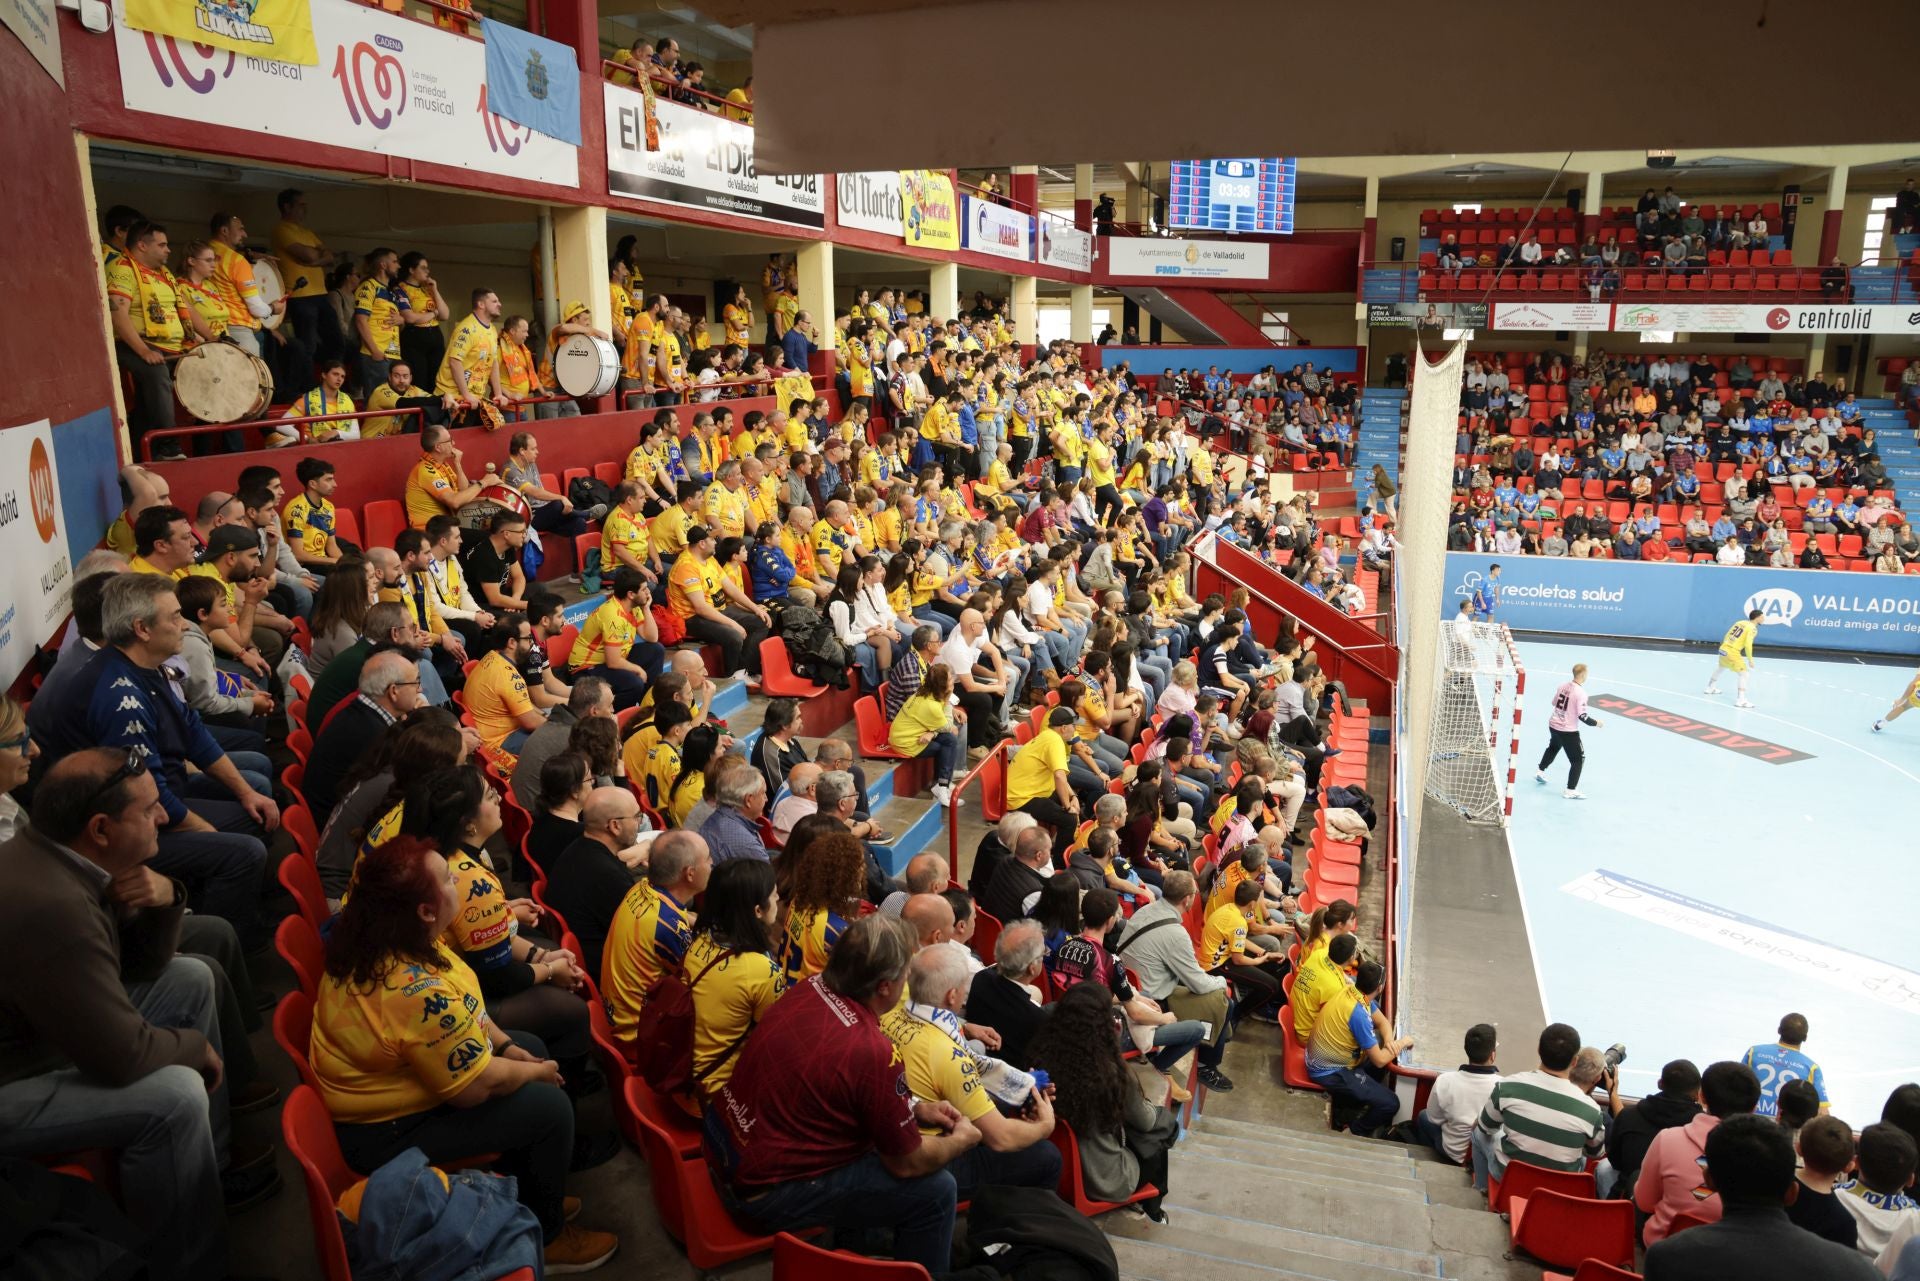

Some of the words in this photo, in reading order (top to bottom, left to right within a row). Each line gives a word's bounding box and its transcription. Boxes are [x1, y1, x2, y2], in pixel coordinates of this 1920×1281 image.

[374, 34, 403, 51] CADENA
[246, 56, 302, 81] musical
[420, 72, 438, 85] mejor
[413, 83, 447, 99] variedad
[413, 96, 455, 116] musical
[618, 106, 641, 152] El
[726, 140, 758, 180] Día
[648, 161, 656, 172] de
[656, 162, 686, 179] Valladolid
[727, 179, 735, 189] de
[735, 178, 759, 195] Valladolid
[791, 194, 798, 203] de
[798, 194, 817, 207] Valladolid
[839, 172, 858, 215] El
[860, 174, 896, 221] Norte
[1138, 248, 1182, 257] Ayuntamiento
[1202, 250, 1211, 259] de
[1213, 251, 1245, 260] Valladolid
[1155, 265, 1181, 275] FMD
[1798, 308, 1872, 329] centrolid
[41, 556, 68, 596] VALLADOLID
[1501, 584, 1577, 600] recoletas
[1581, 586, 1624, 602] salud
[1751, 598, 1793, 618] VA!
[1729, 626, 1744, 638] 30
[1804, 617, 1841, 628] ciudad
[1844, 619, 1879, 631] amiga
[1882, 621, 1900, 631] del
[1556, 693, 1569, 711] 21
[1059, 944, 1092, 964] CERES
[1718, 928, 1841, 972] recoletas
[1756, 1063, 1800, 1097] 28
